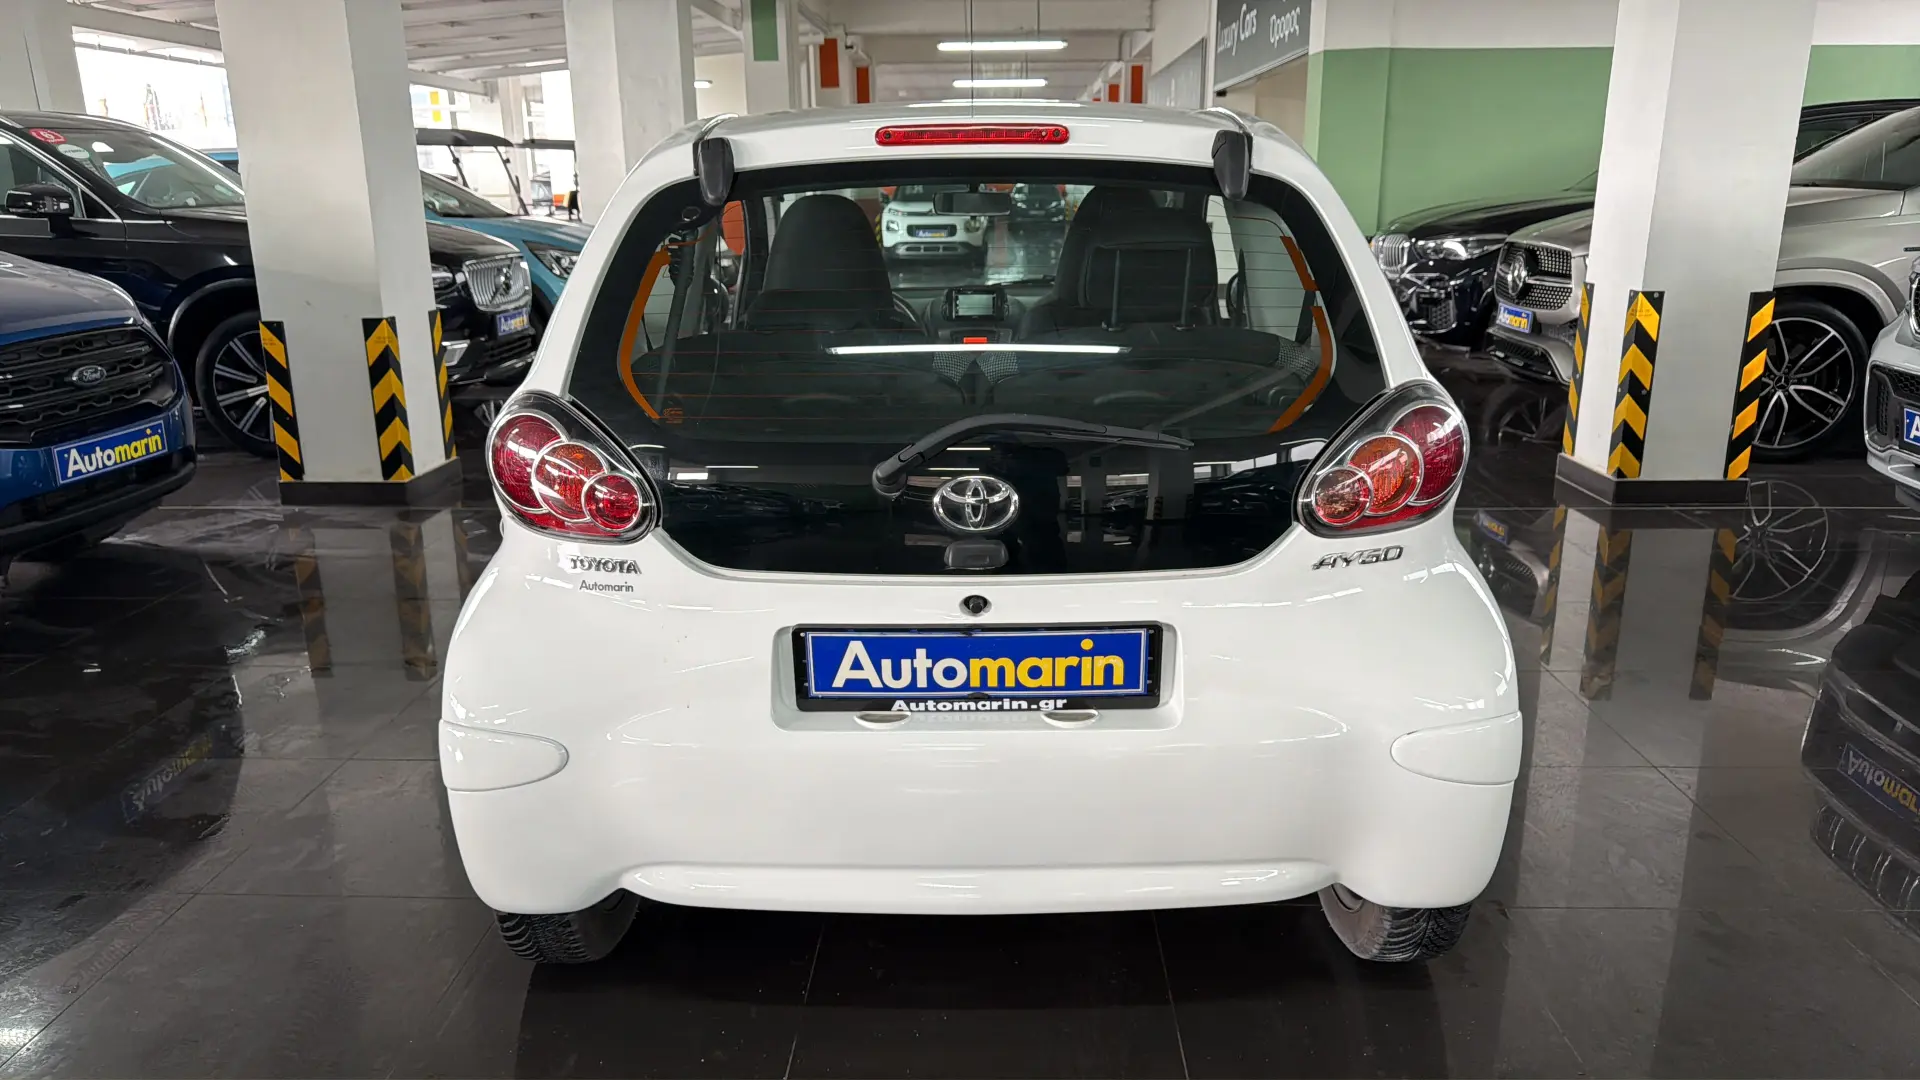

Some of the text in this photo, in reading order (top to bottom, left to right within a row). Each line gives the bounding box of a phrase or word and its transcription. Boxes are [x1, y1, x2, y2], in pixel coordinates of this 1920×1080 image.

[1217, 3, 1258, 56] Luxury Cars
[83, 369, 101, 380] Ford
[67, 428, 162, 478] Automarin
[569, 556, 642, 574] TOYOTA
[1312, 545, 1404, 571] AYGO
[579, 579, 634, 592] Automarin
[831, 638, 1125, 689] Automarin
[890, 698, 1067, 712] Automarin.gr
